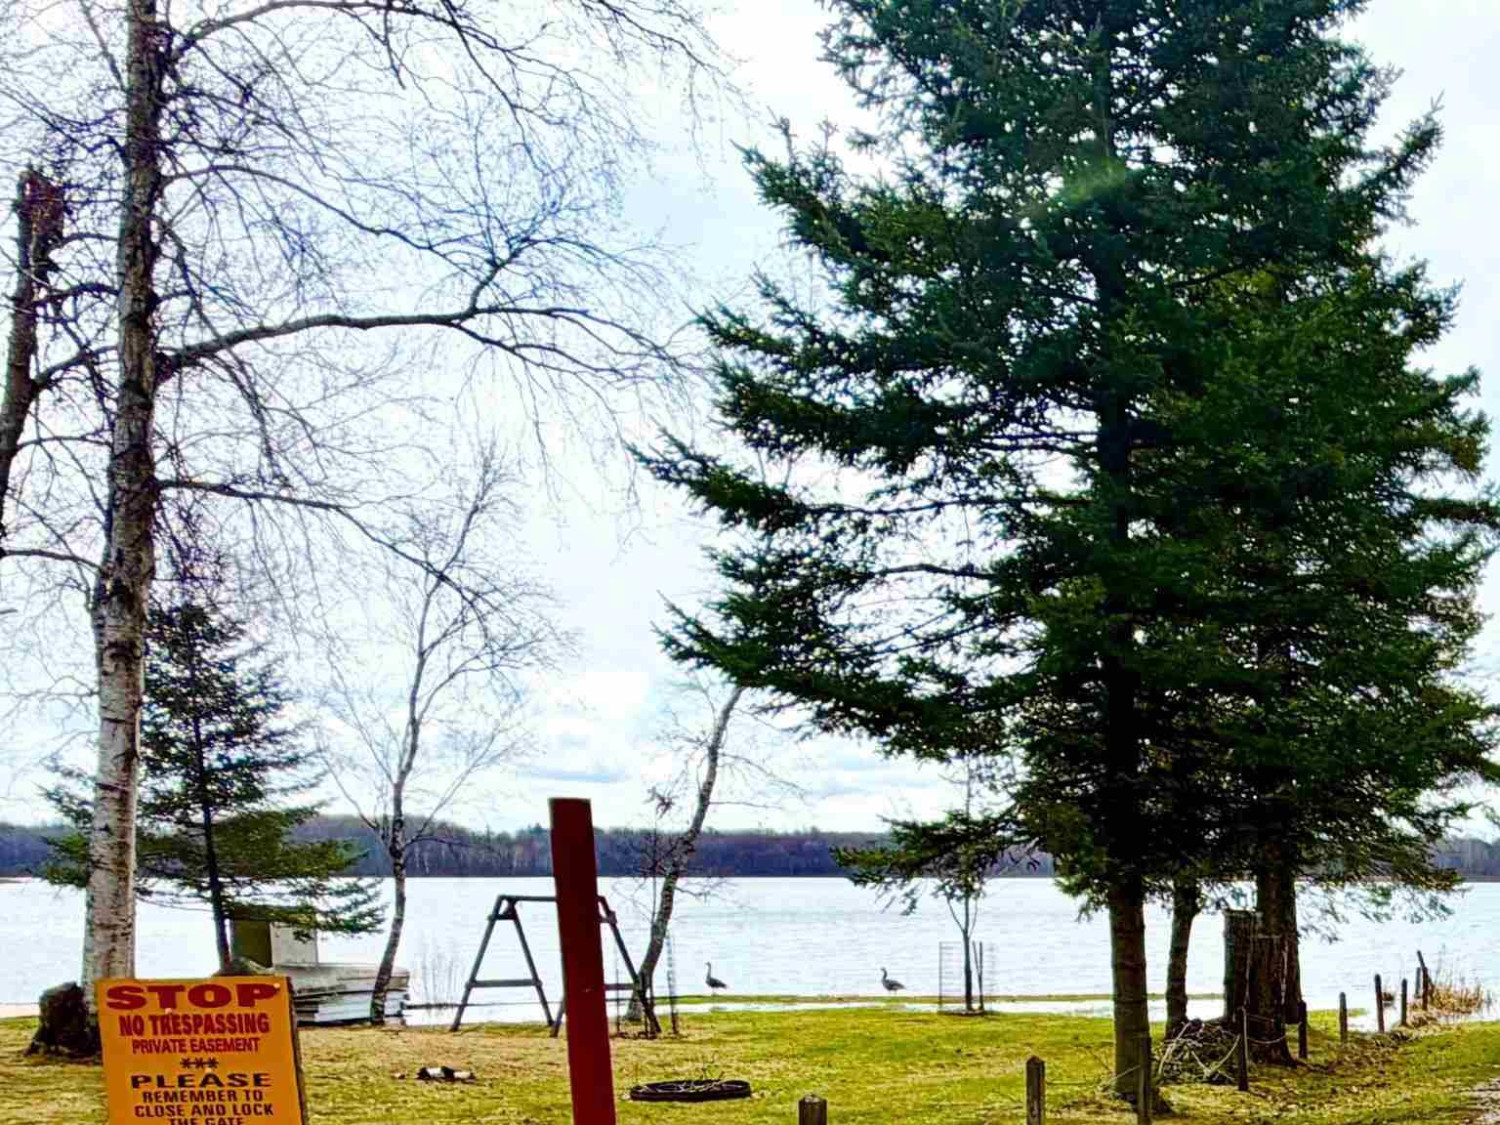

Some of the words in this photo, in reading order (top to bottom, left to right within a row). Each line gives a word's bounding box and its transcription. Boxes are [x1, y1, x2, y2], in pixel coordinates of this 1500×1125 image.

[107, 984, 280, 1011] STOP
[120, 1014, 145, 1037] NO
[149, 1012, 270, 1036] TRESPASSING
[132, 1039, 187, 1054] PRIVATE
[190, 1037, 261, 1052] EASEMENT
[131, 1073, 272, 1089] PLEASE
[142, 1090, 237, 1104] REMEMBER
[244, 1089, 263, 1101] TO
[134, 1105, 185, 1118] CLOSE
[191, 1104, 226, 1116] AND
[233, 1103, 274, 1116] LOCK
